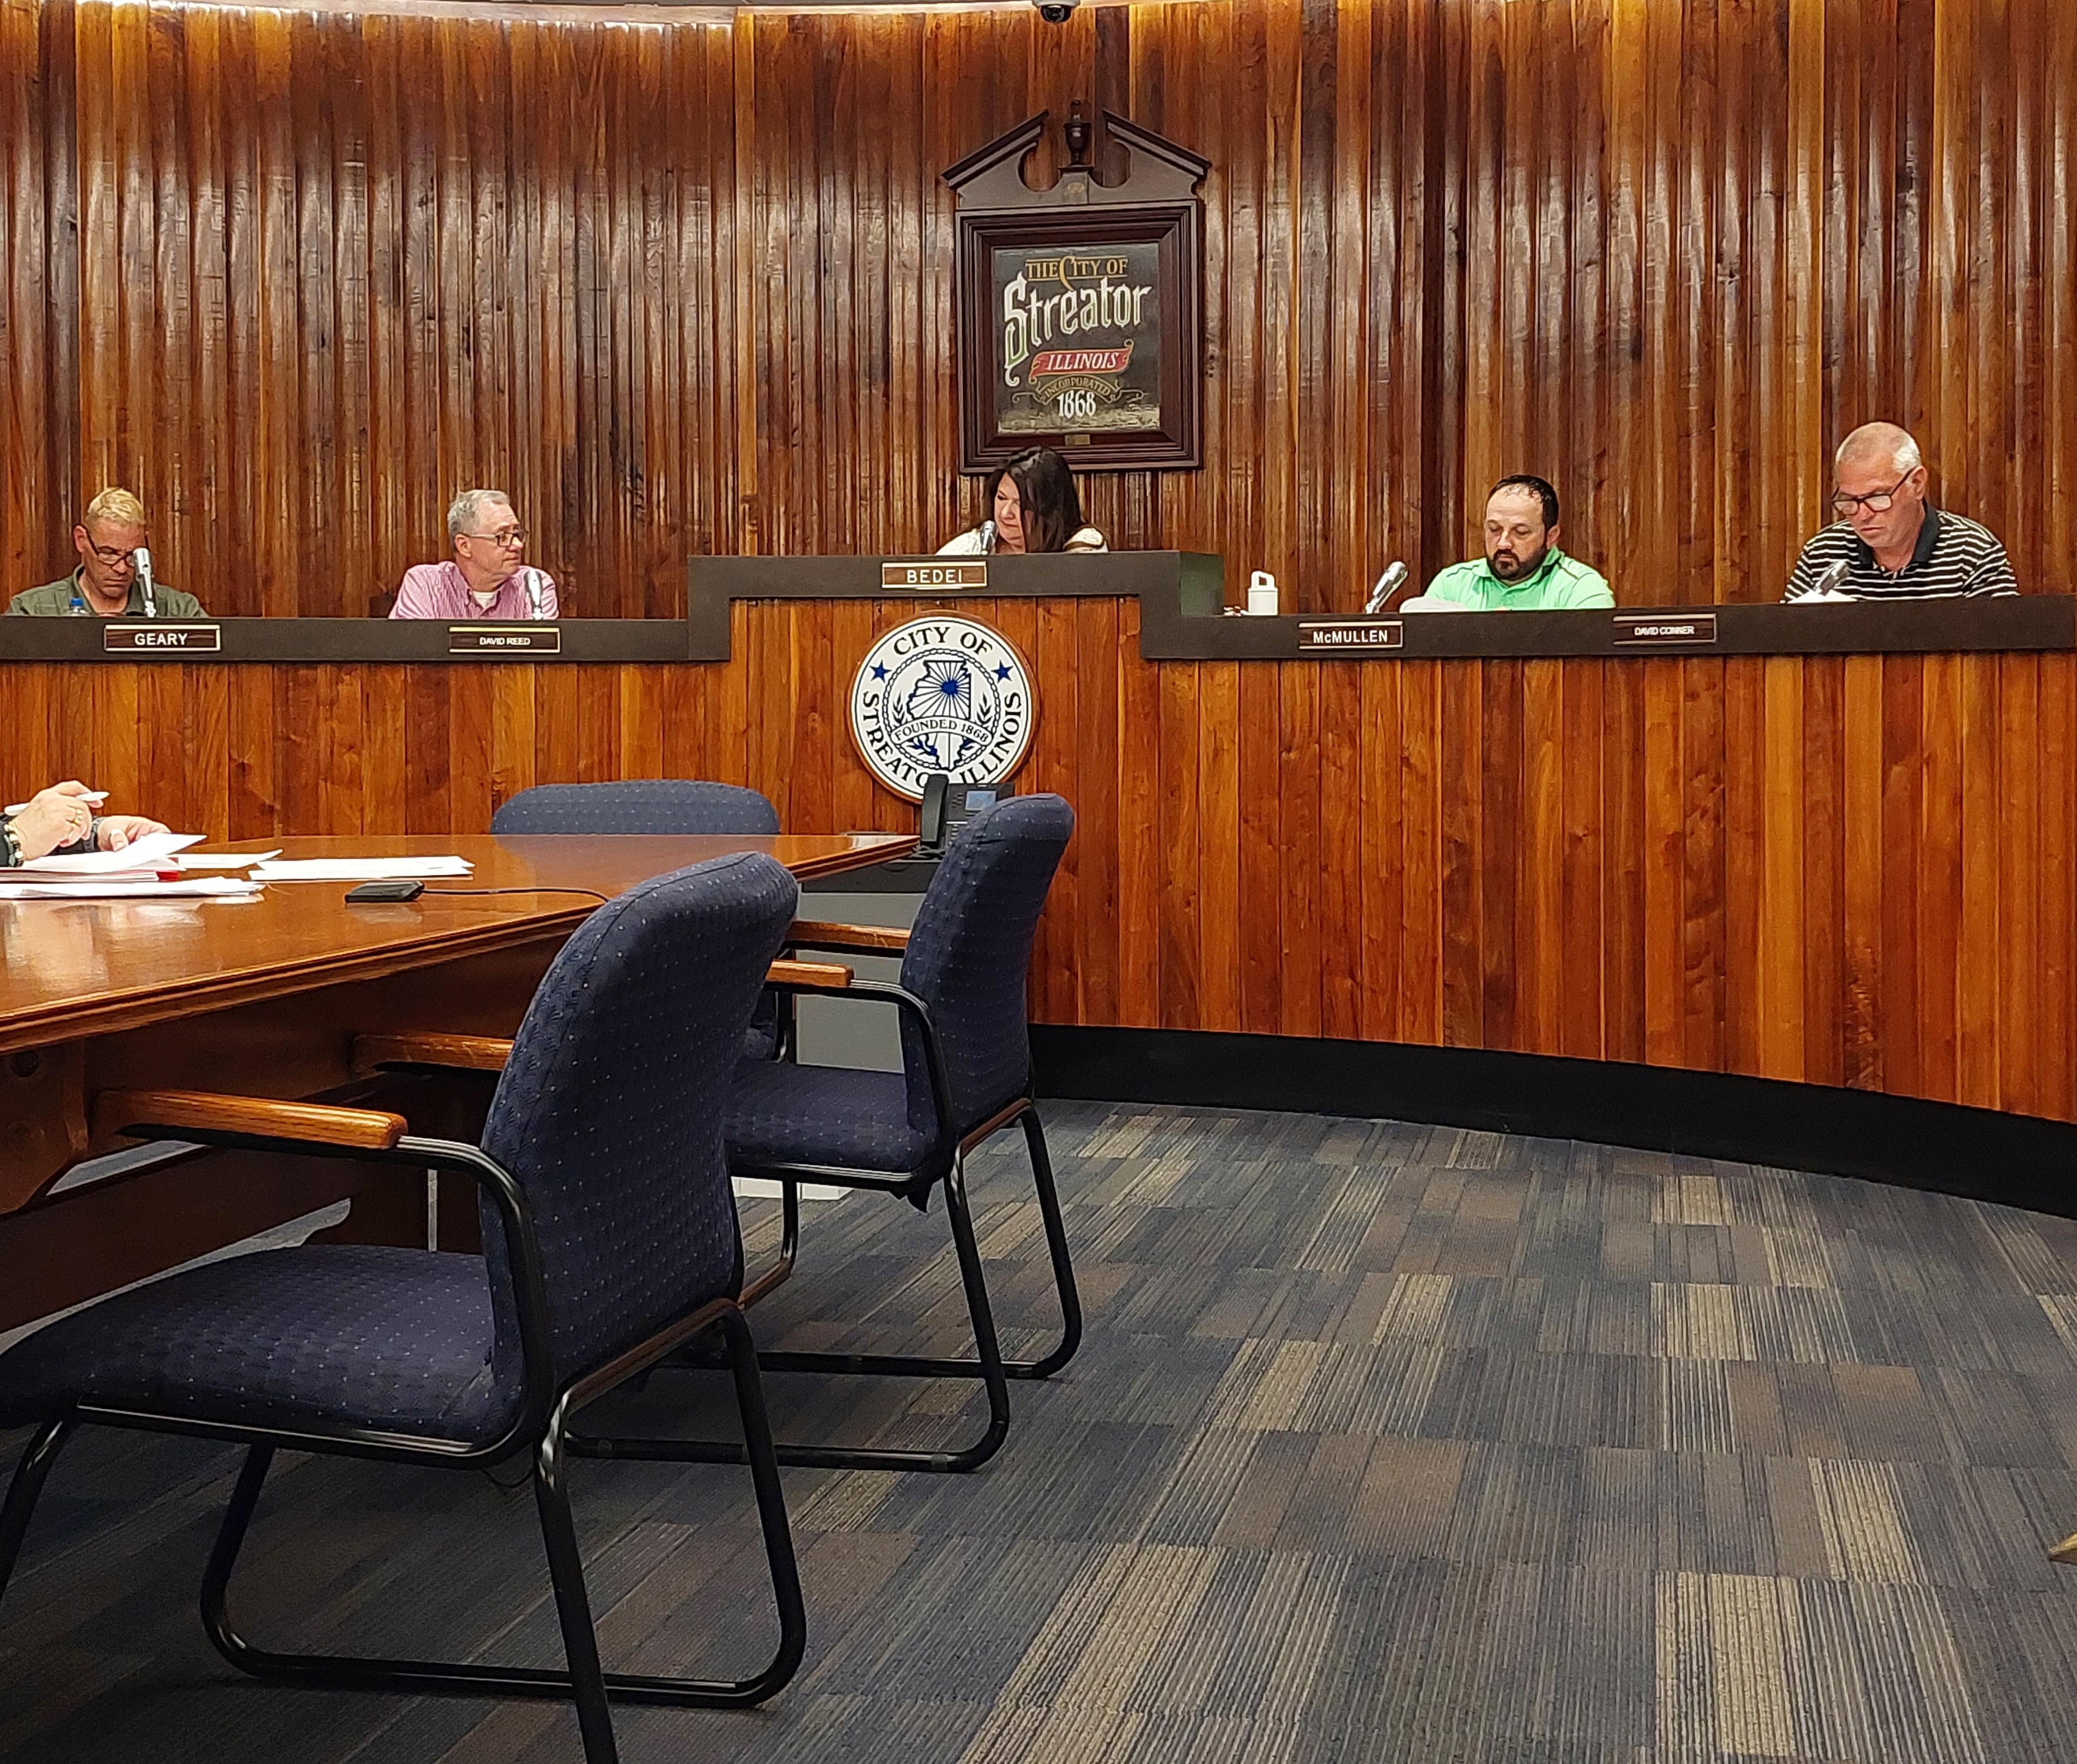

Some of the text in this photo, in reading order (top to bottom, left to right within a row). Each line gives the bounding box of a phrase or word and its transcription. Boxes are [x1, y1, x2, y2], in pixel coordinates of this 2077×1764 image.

[1026, 256, 1128, 290] THE CITY OF
[1004, 271, 1152, 387] Streator
[1046, 353, 1119, 370] ILLINOIS
[1044, 377, 1111, 397] INCORPORATED
[1057, 390, 1096, 419] 1868
[907, 569, 961, 583] BEDEI
[134, 632, 188, 645] GEARY
[1313, 629, 1388, 644] McMULLEN
[1634, 626, 1658, 635] DAVID
[479, 637, 530, 645] DAVID REED
[894, 627, 993, 655] CITY OF
[863, 691, 1021, 788] STREATO ILLINOIS
[894, 719, 989, 742] FOUNDED 1868
